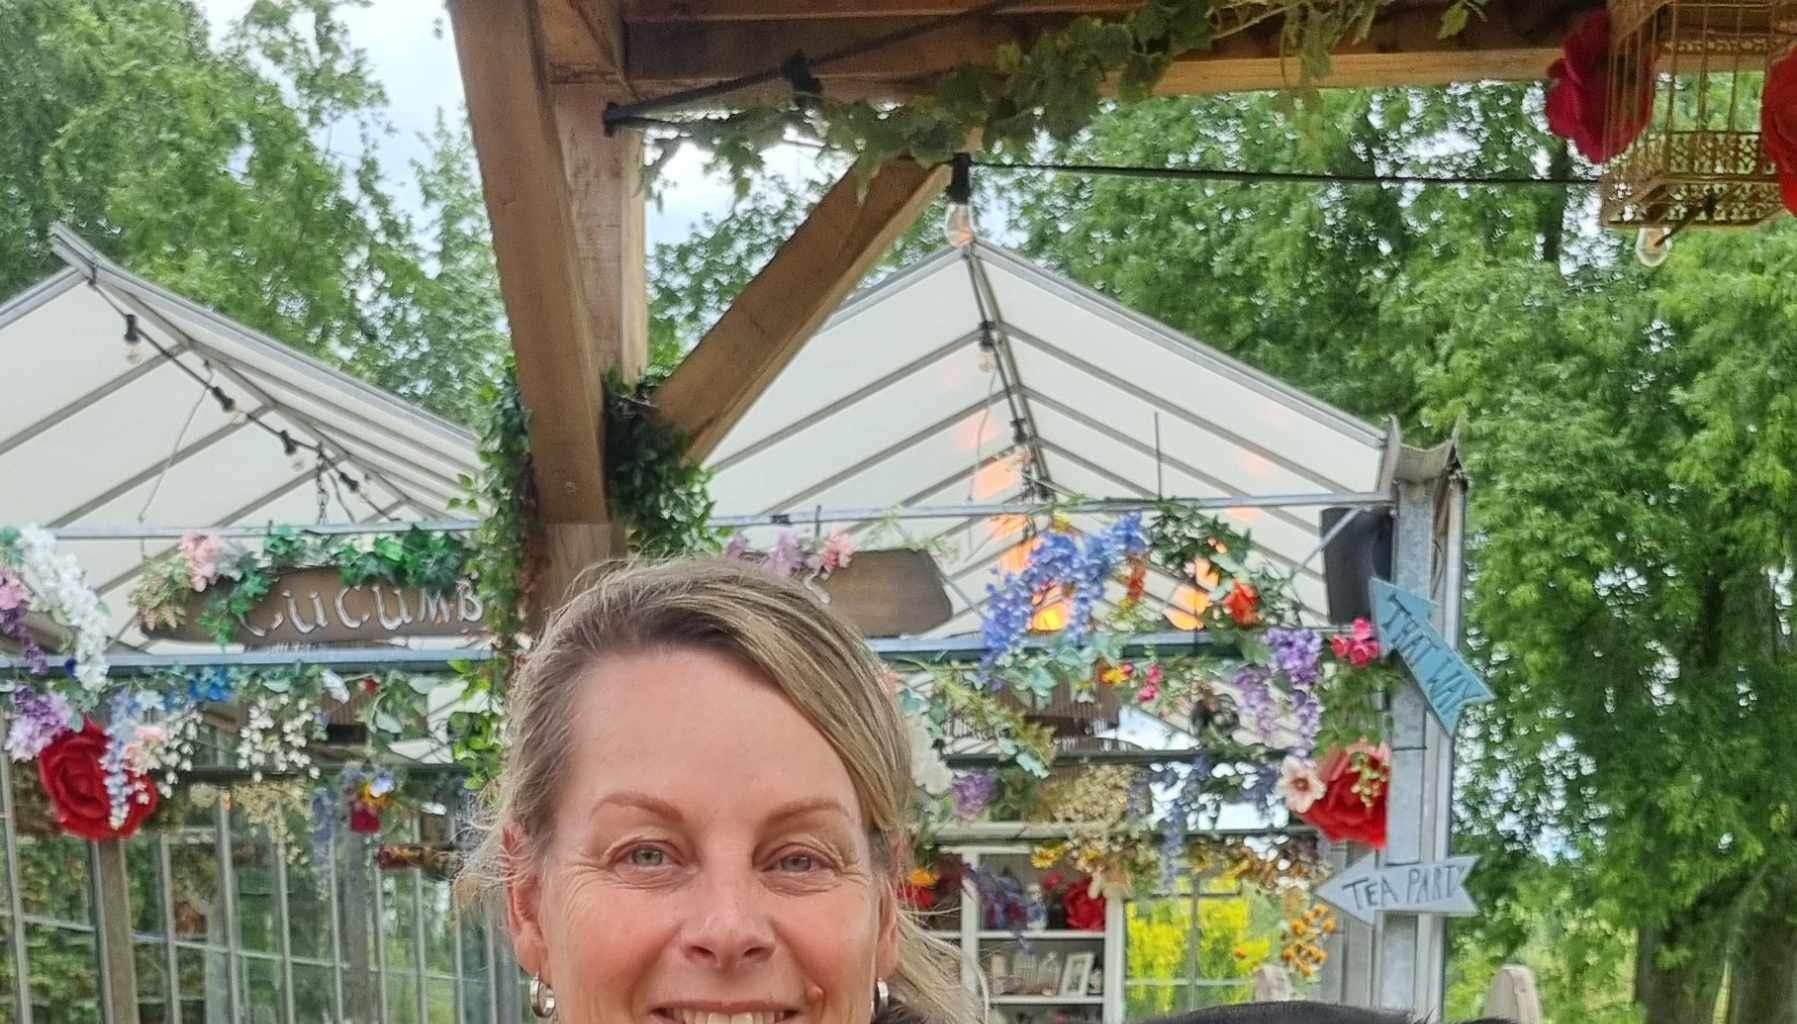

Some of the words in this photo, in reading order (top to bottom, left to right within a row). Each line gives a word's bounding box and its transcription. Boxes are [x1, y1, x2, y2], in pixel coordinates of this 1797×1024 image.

[1381, 593, 1441, 664] THAT
[1426, 657, 1484, 712] WAY
[1341, 876, 1399, 910] TEA
[1407, 864, 1467, 904] PARTY
